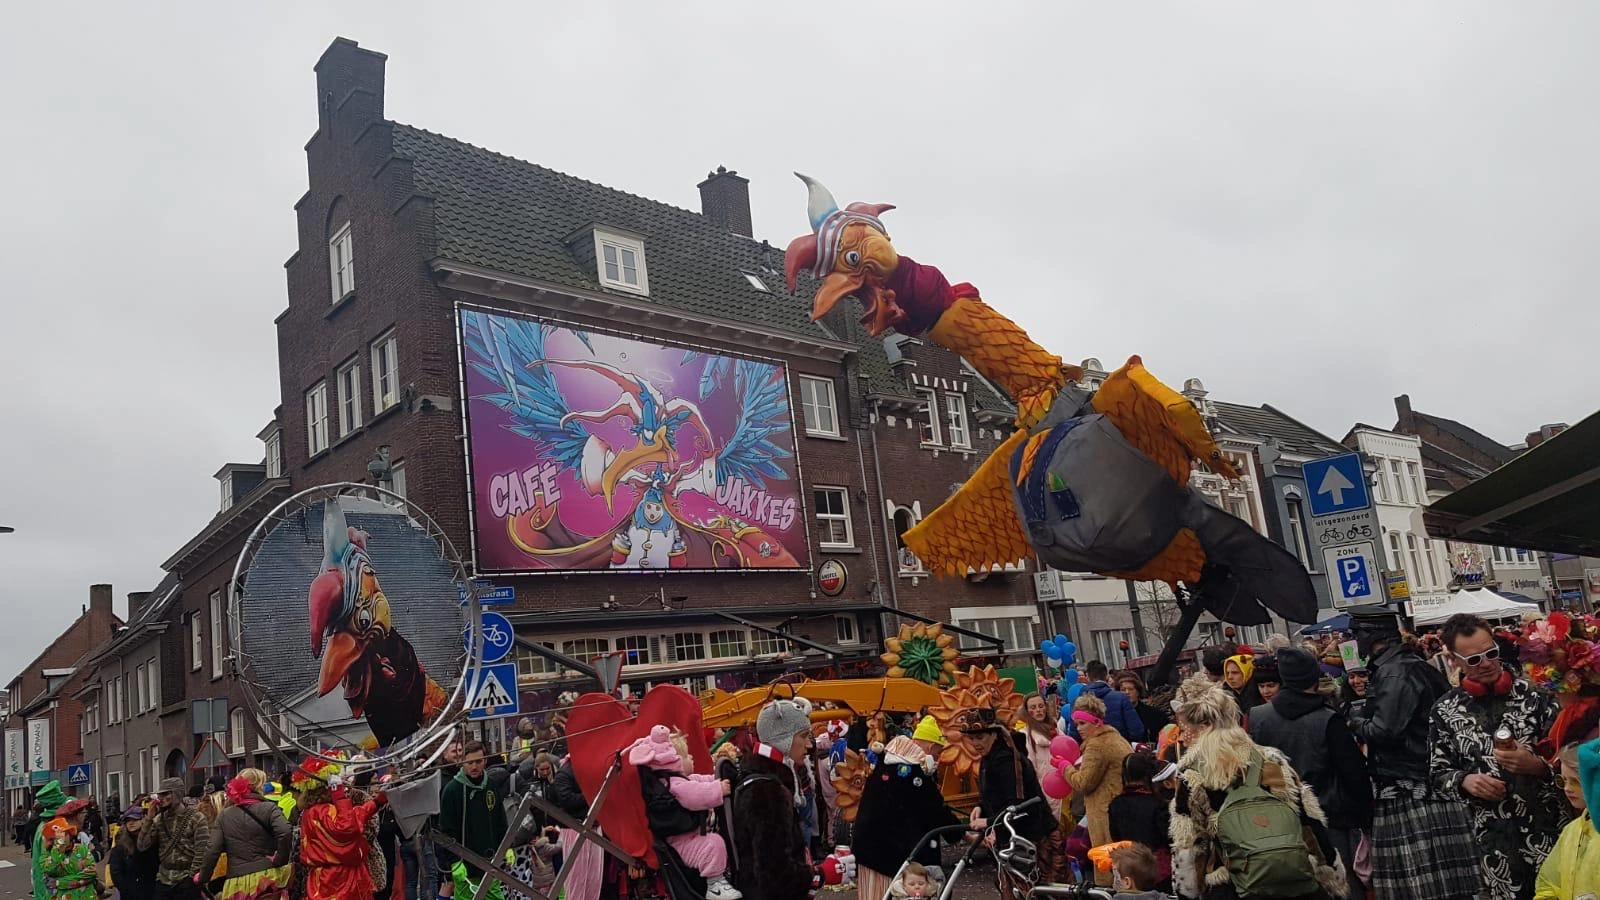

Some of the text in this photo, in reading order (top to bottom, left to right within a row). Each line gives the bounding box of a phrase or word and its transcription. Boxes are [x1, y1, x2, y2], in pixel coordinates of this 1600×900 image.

[489, 460, 796, 531] CAFÉ JAKKES
[1315, 512, 1370, 527] uitgezonderd
[1337, 547, 1360, 556] ZONE
